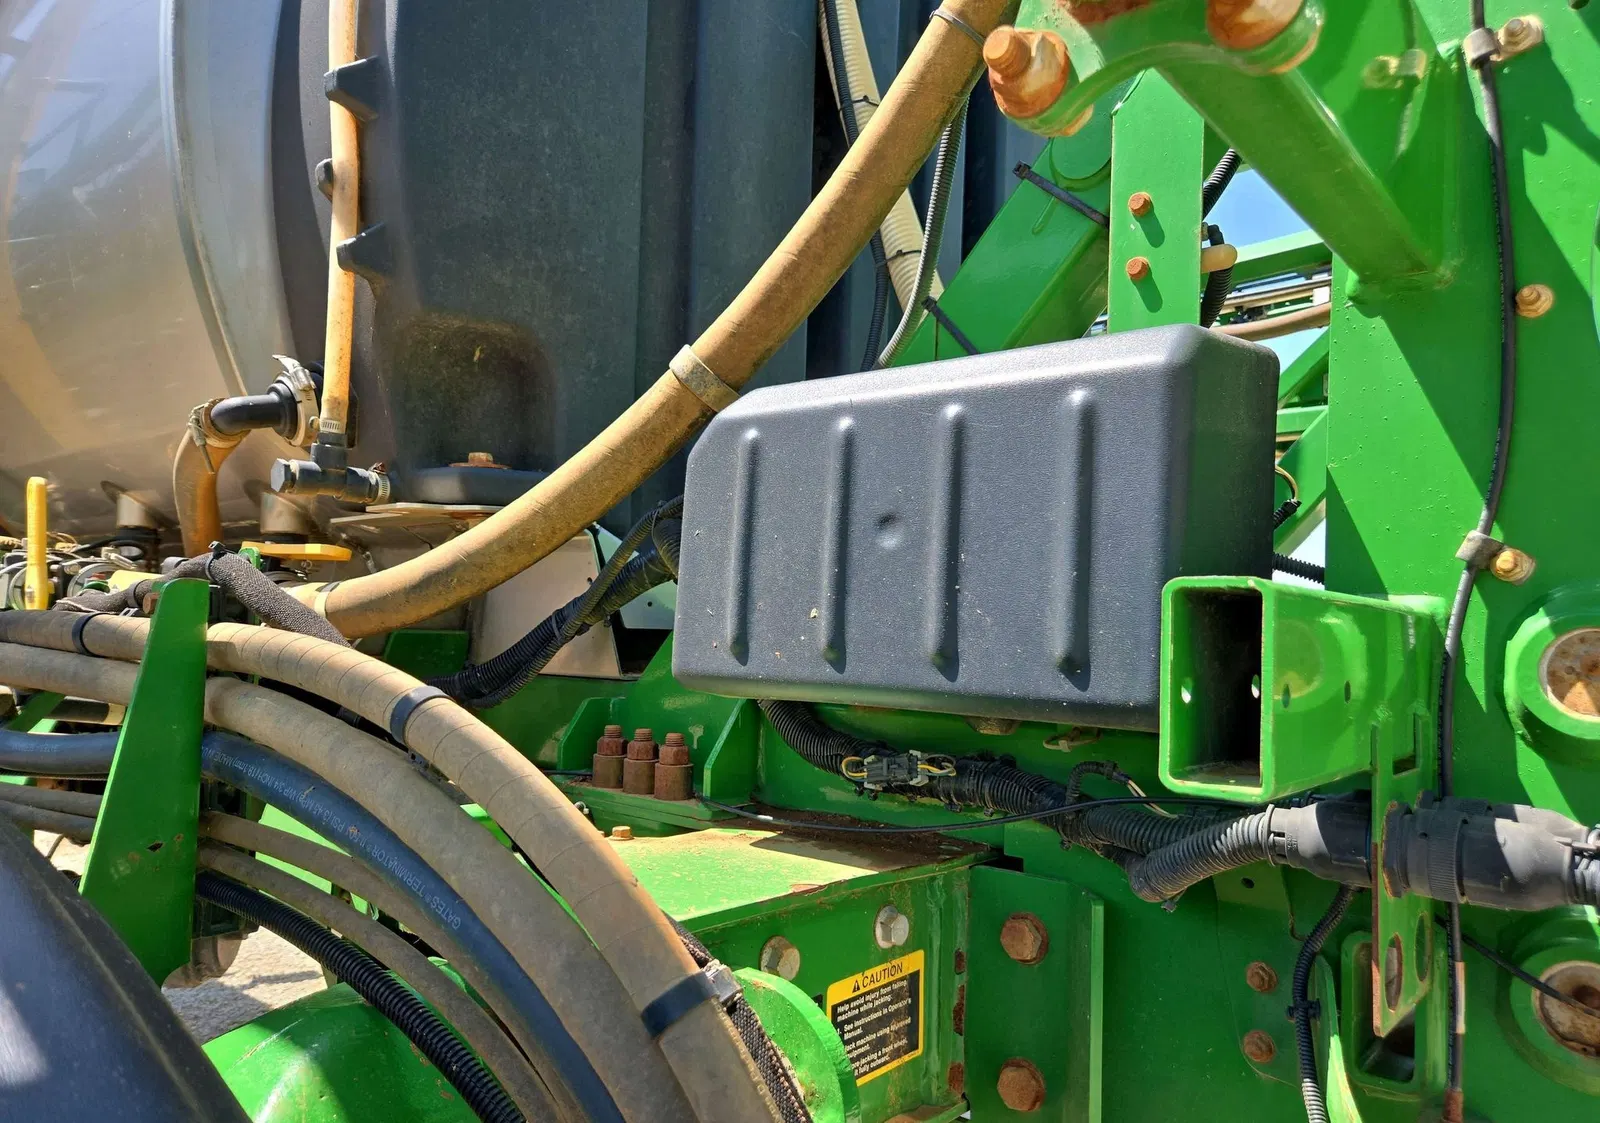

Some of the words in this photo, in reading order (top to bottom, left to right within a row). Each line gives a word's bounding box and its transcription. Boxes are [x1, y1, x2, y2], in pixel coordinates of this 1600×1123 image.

[330, 816, 346, 833] PSI
[862, 962, 903, 988] CAUTION
[837, 1003, 850, 1014] Help
[850, 996, 865, 1008] avoid
[865, 991, 879, 1002] injury
[880, 986, 892, 994] from
[892, 979, 907, 989] falling
[837, 1009, 859, 1022] machine
[860, 1001, 873, 1012] while
[844, 1023, 854, 1032] See
[854, 1010, 882, 1027] instructions
[882, 1007, 888, 1015] in
[844, 1026, 863, 1040] Manual.
[856, 1033, 877, 1047] machine
[877, 1027, 890, 1038] using
[859, 1063, 870, 1074] fully
[860, 1052, 877, 1067] jacking
